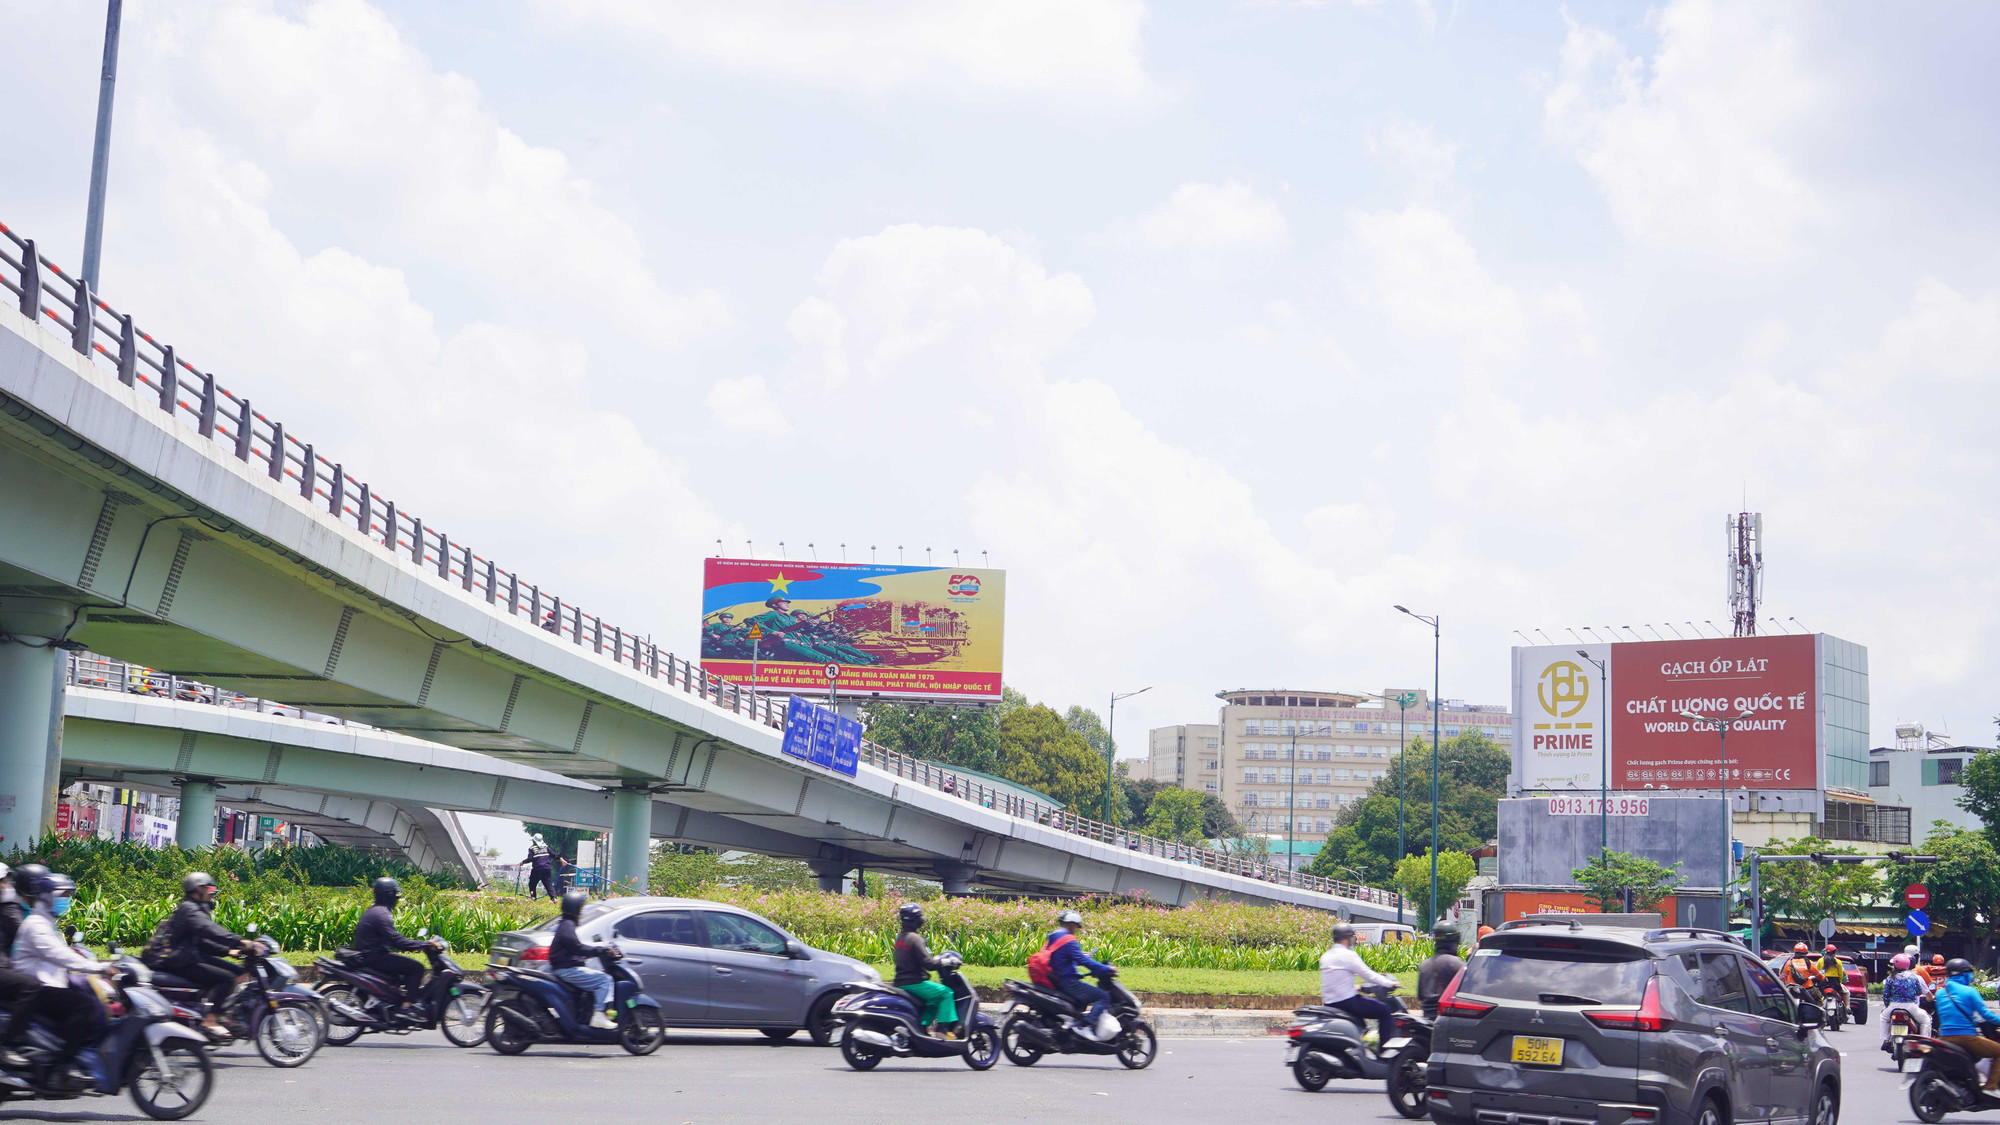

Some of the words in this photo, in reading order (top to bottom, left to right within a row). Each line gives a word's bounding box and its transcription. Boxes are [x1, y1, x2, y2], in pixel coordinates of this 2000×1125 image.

[763, 667, 781, 675] PHÁT
[798, 668, 810, 676] GIÁ
[812, 669, 823, 677] TRỊ
[840, 669, 860, 678] HẮNG
[862, 671, 877, 679] MÙA
[879, 671, 898, 679] XUÂN
[900, 672, 916, 680] NĂM
[1660, 661, 1705, 677] GẠCH
[1709, 656, 1732, 673] ỐP
[1736, 657, 1768, 672] LÁT
[771, 675, 779, 683] VỆ
[781, 675, 795, 683] ĐẤT
[795, 676, 814, 684] NƯỚC
[886, 680, 904, 688] PHÁT
[929, 682, 941, 690] HỘI
[942, 682, 962, 690] NHẬP
[963, 682, 982, 691] QUỐC
[983, 683, 992, 691] TẾ
[1626, 696, 1667, 713] CHẤT
[1671, 697, 1729, 715] LƯỢNG
[1733, 692, 1783, 711] QUỐC
[1788, 691, 1807, 710] TẾ
[1440, 711, 1459, 723] ỆNH
[1644, 721, 1689, 733] WORLD
[1733, 719, 1787, 732] QUALITY
[1533, 734, 1593, 750] PRIME
[1550, 798, 1648, 815] 0913.173.956
[1528, 1038, 1549, 1050] 50H
[1517, 1049, 1556, 1063] 592.64
